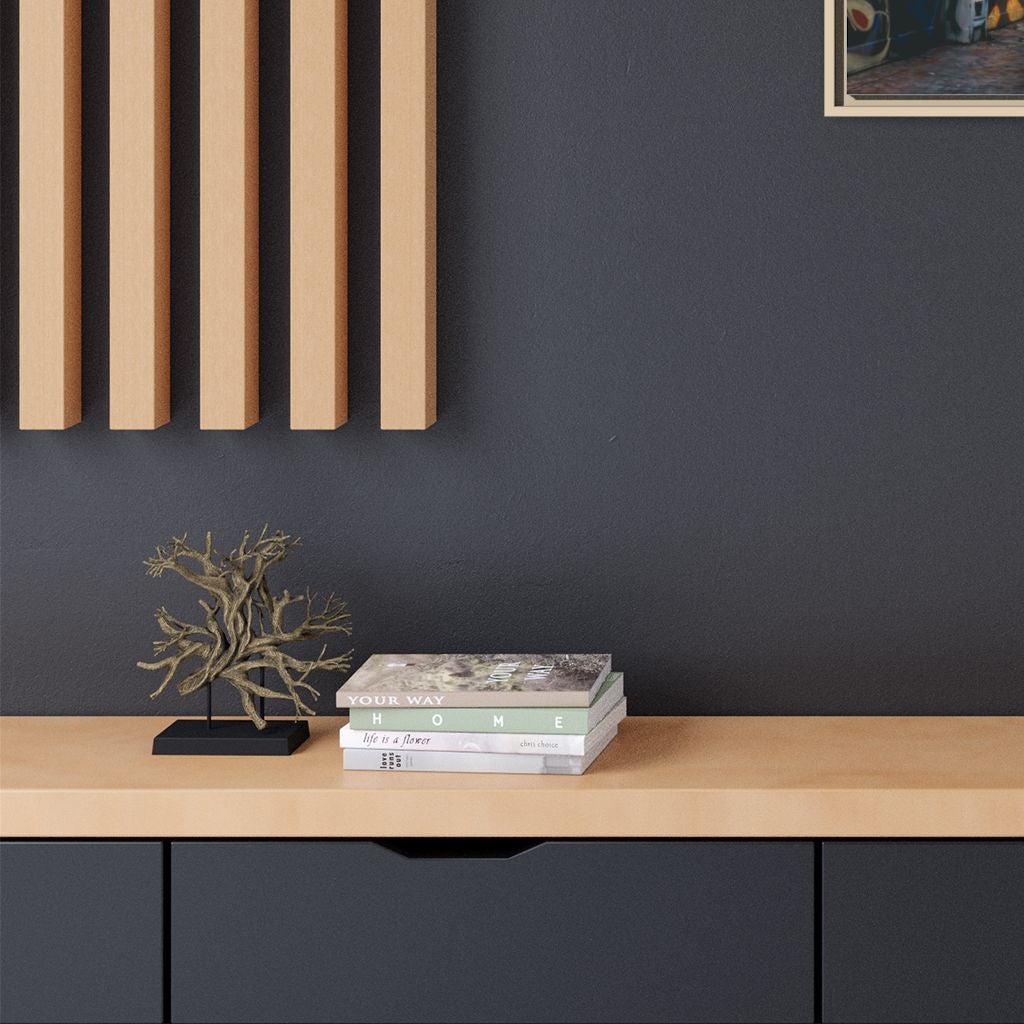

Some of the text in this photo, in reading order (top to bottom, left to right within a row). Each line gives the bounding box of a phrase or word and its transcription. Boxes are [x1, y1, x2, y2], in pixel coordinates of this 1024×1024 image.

[347, 696, 446, 705] YOUR WAY
[363, 732, 432, 748] life is a flower
[520, 739, 559, 749] chris choice
[380, 752, 388, 769] love
